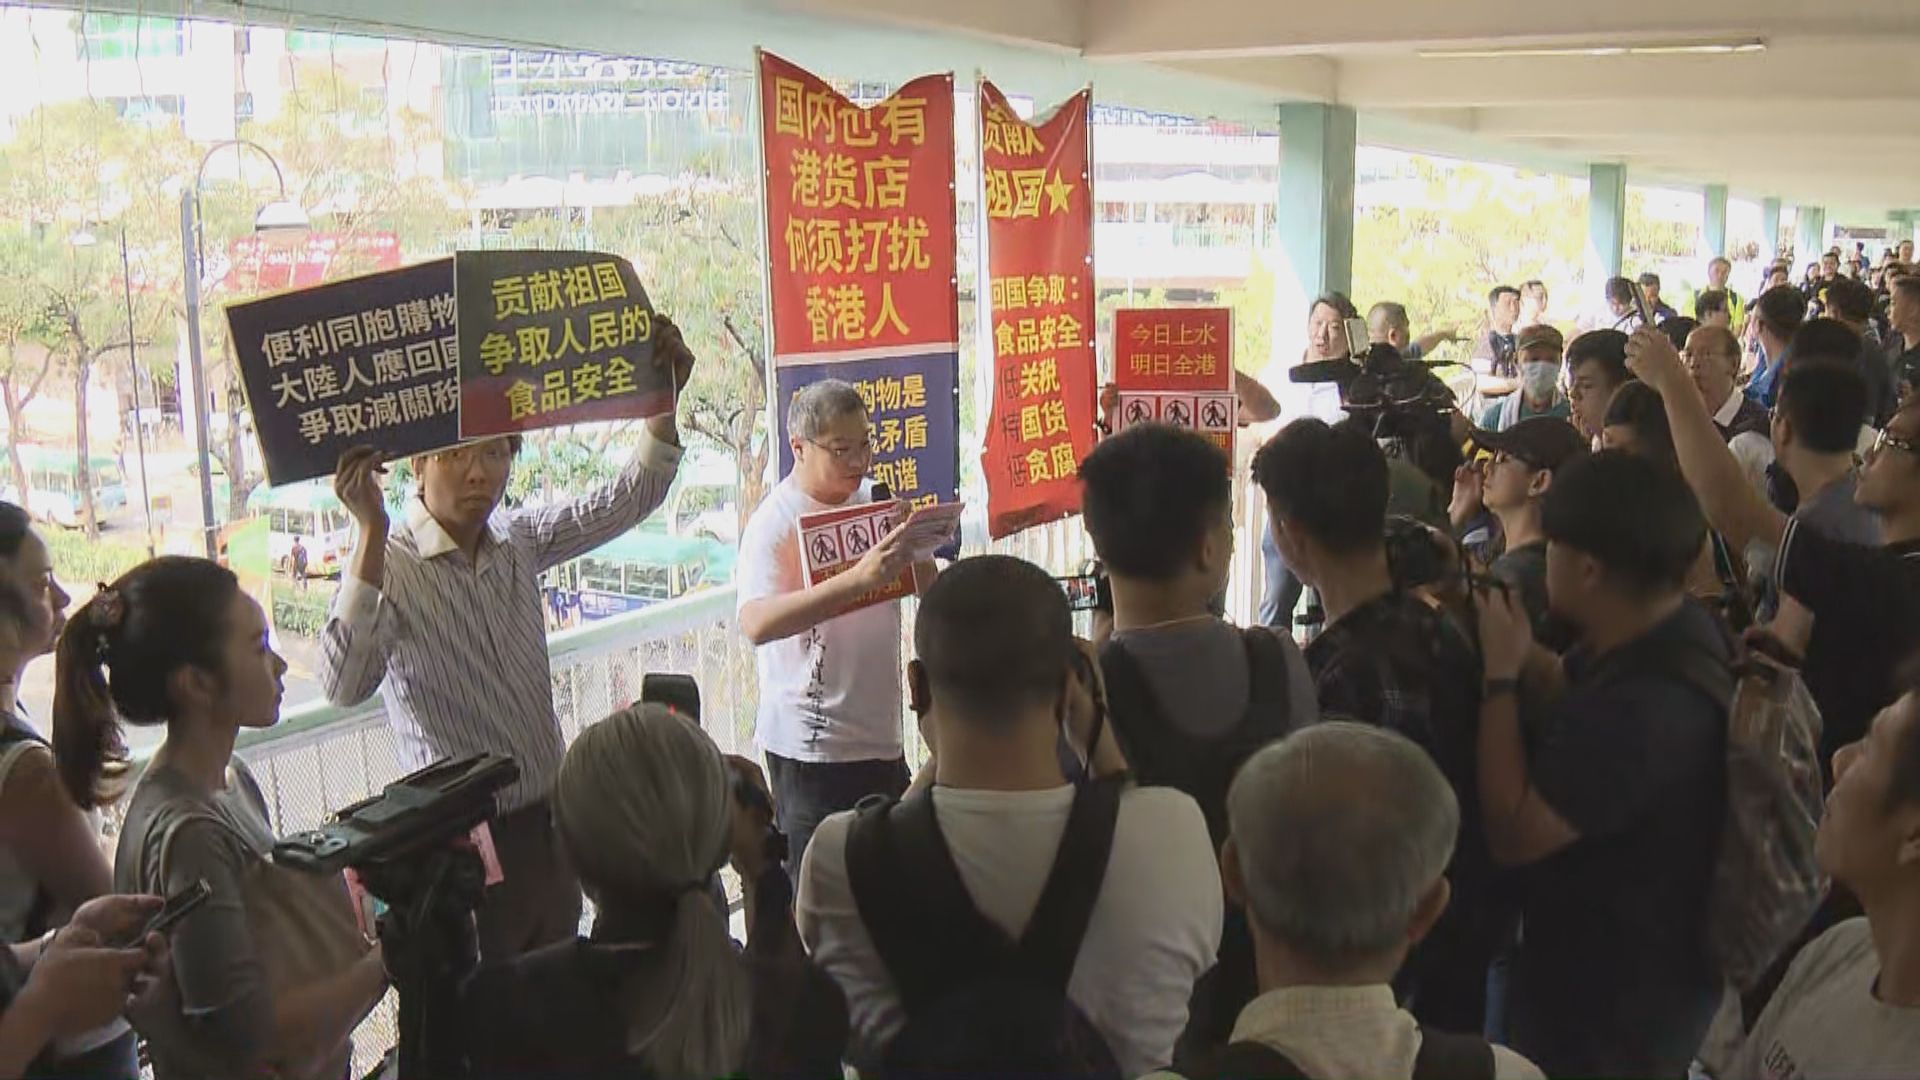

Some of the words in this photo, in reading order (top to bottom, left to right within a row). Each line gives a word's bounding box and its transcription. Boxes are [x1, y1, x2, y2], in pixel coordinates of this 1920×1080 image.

[774, 76, 928, 148] 国内也有
[789, 147, 911, 210] 港货店
[784, 212, 931, 275] 何须打扰
[491, 261, 628, 321] 贡献祖国
[805, 281, 911, 344] 香港人
[260, 292, 458, 368] 便利同胞購物
[479, 303, 651, 376] 争取人民的
[994, 313, 1082, 358] 食品安全
[1130, 322, 1218, 347] 今日上水
[505, 355, 638, 422] 食品安全
[1130, 353, 1217, 377] 明日全港
[297, 377, 461, 444] 爭取減關稅
